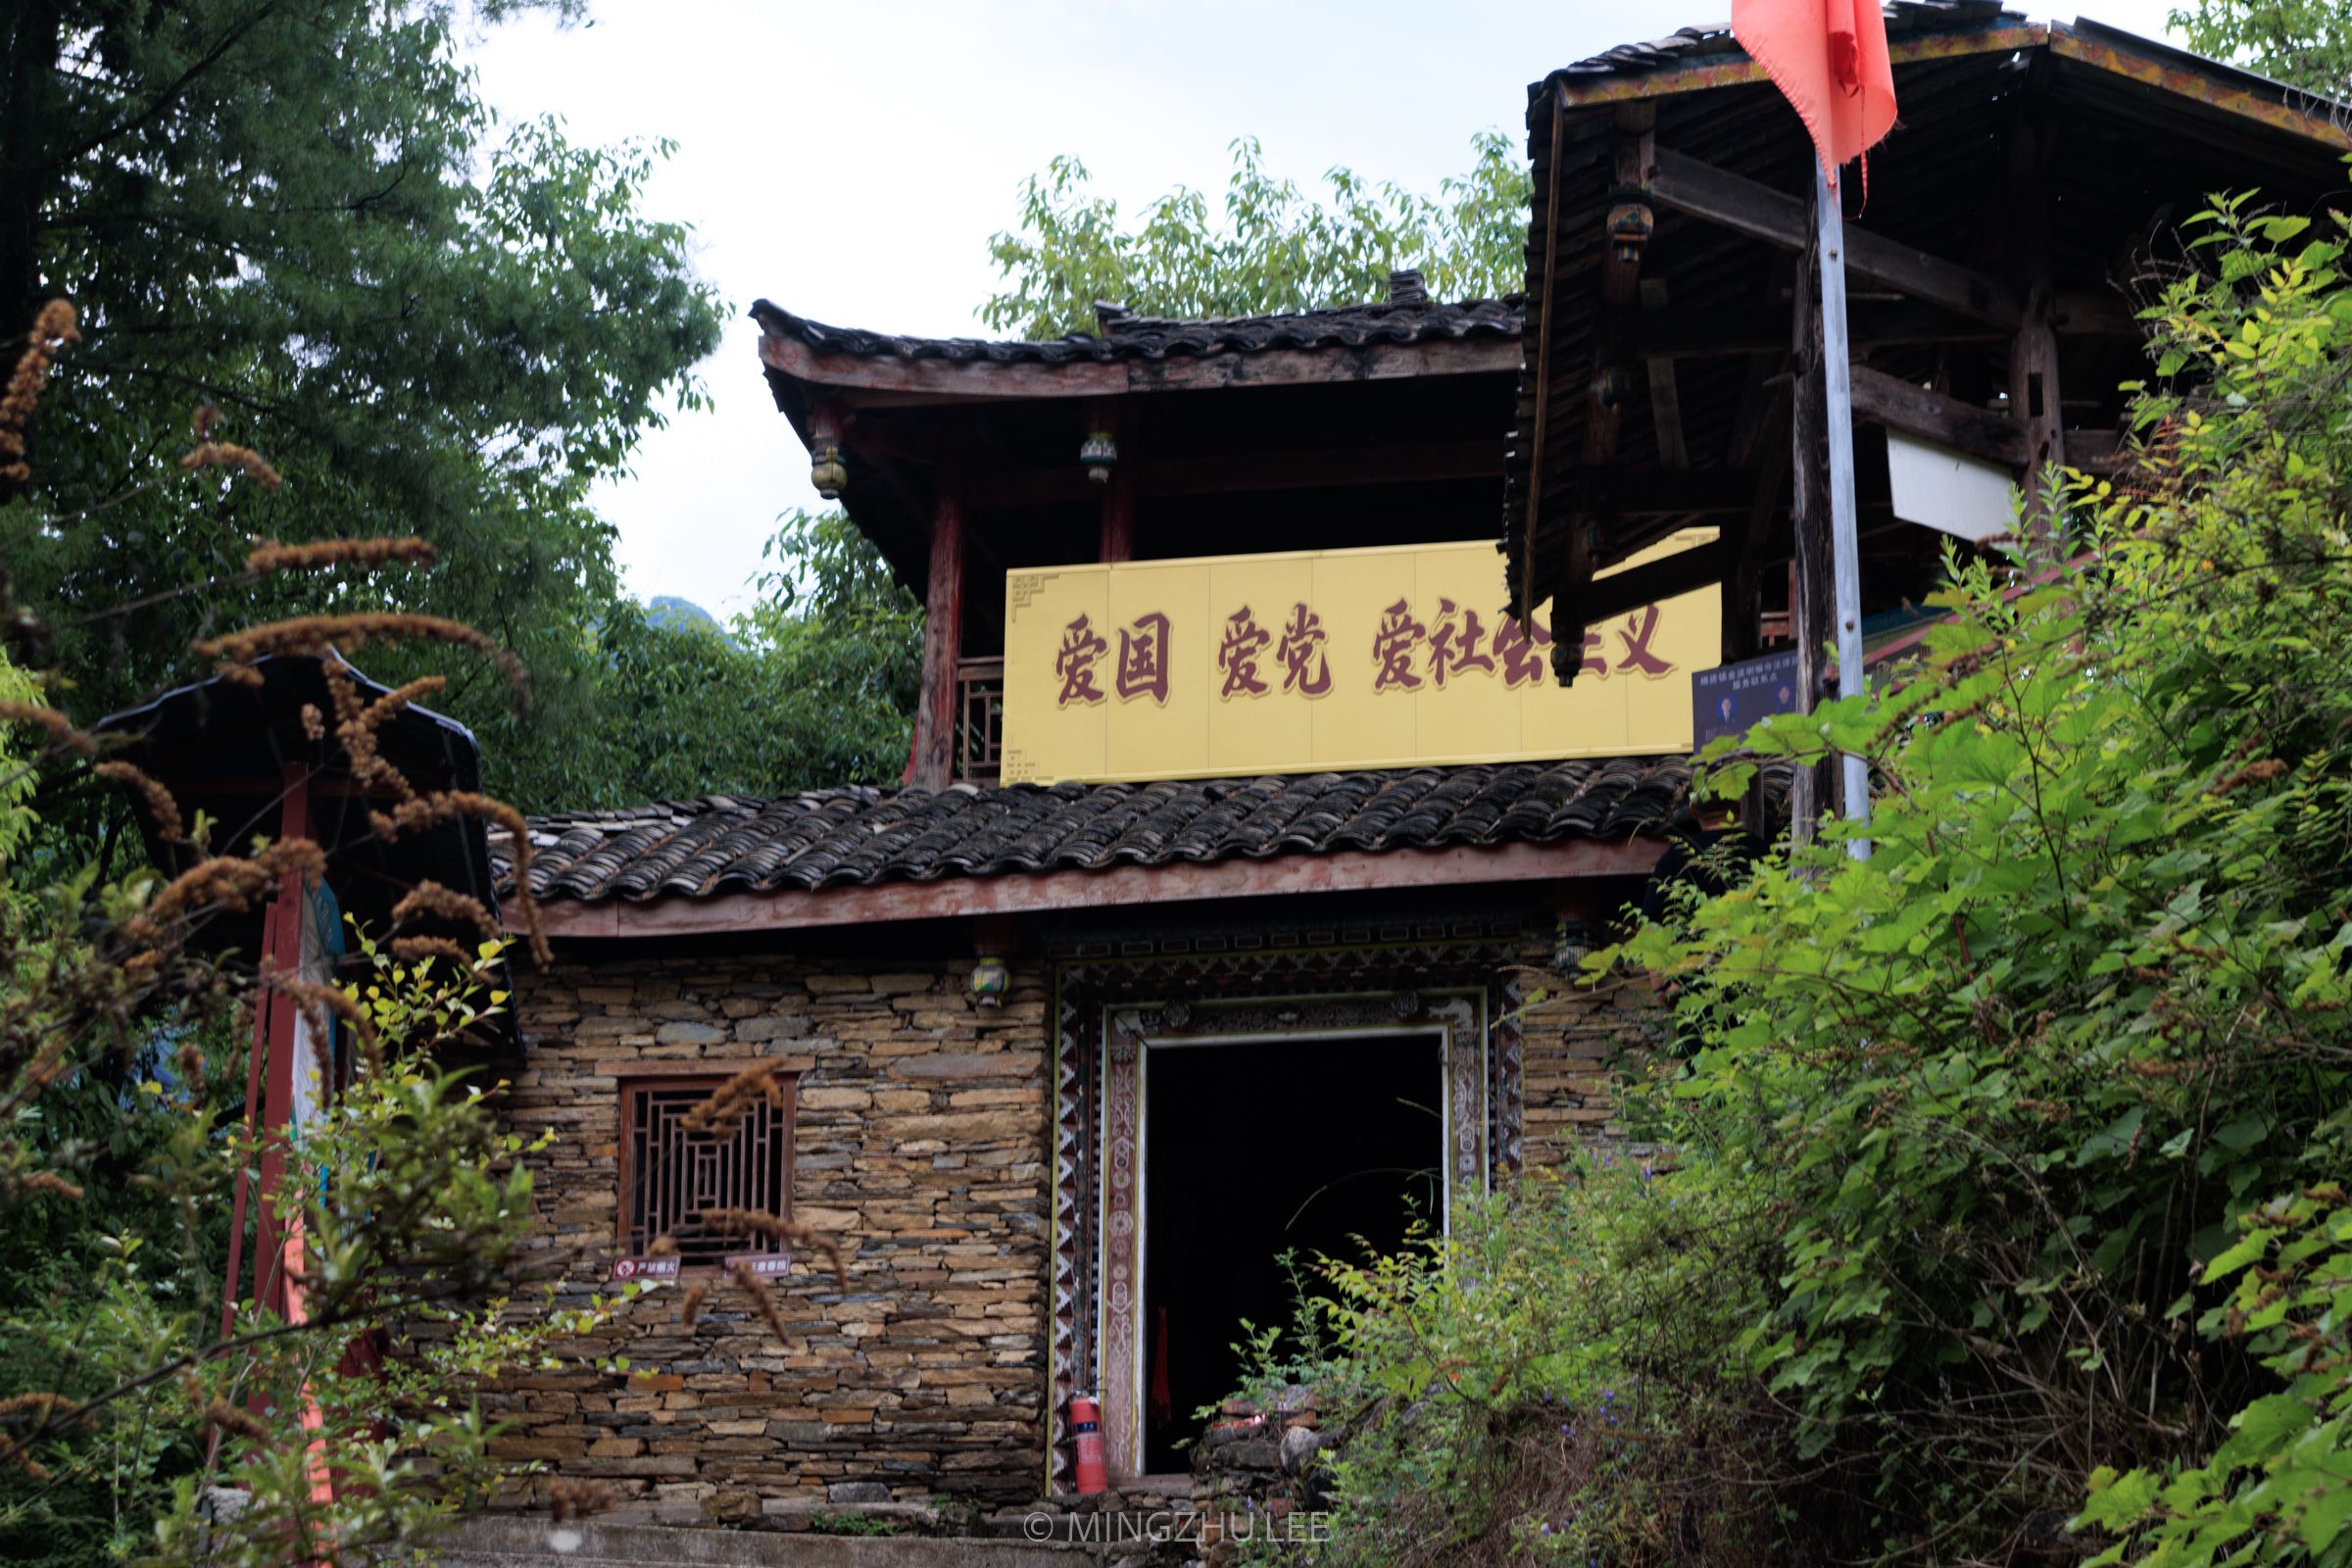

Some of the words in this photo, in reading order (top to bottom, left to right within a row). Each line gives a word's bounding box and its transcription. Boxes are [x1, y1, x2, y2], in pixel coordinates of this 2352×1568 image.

[1055, 613, 1169, 704] 爱国
[1218, 603, 1332, 696] 爱党
[636, 1260, 675, 1274] 严禁烟火
